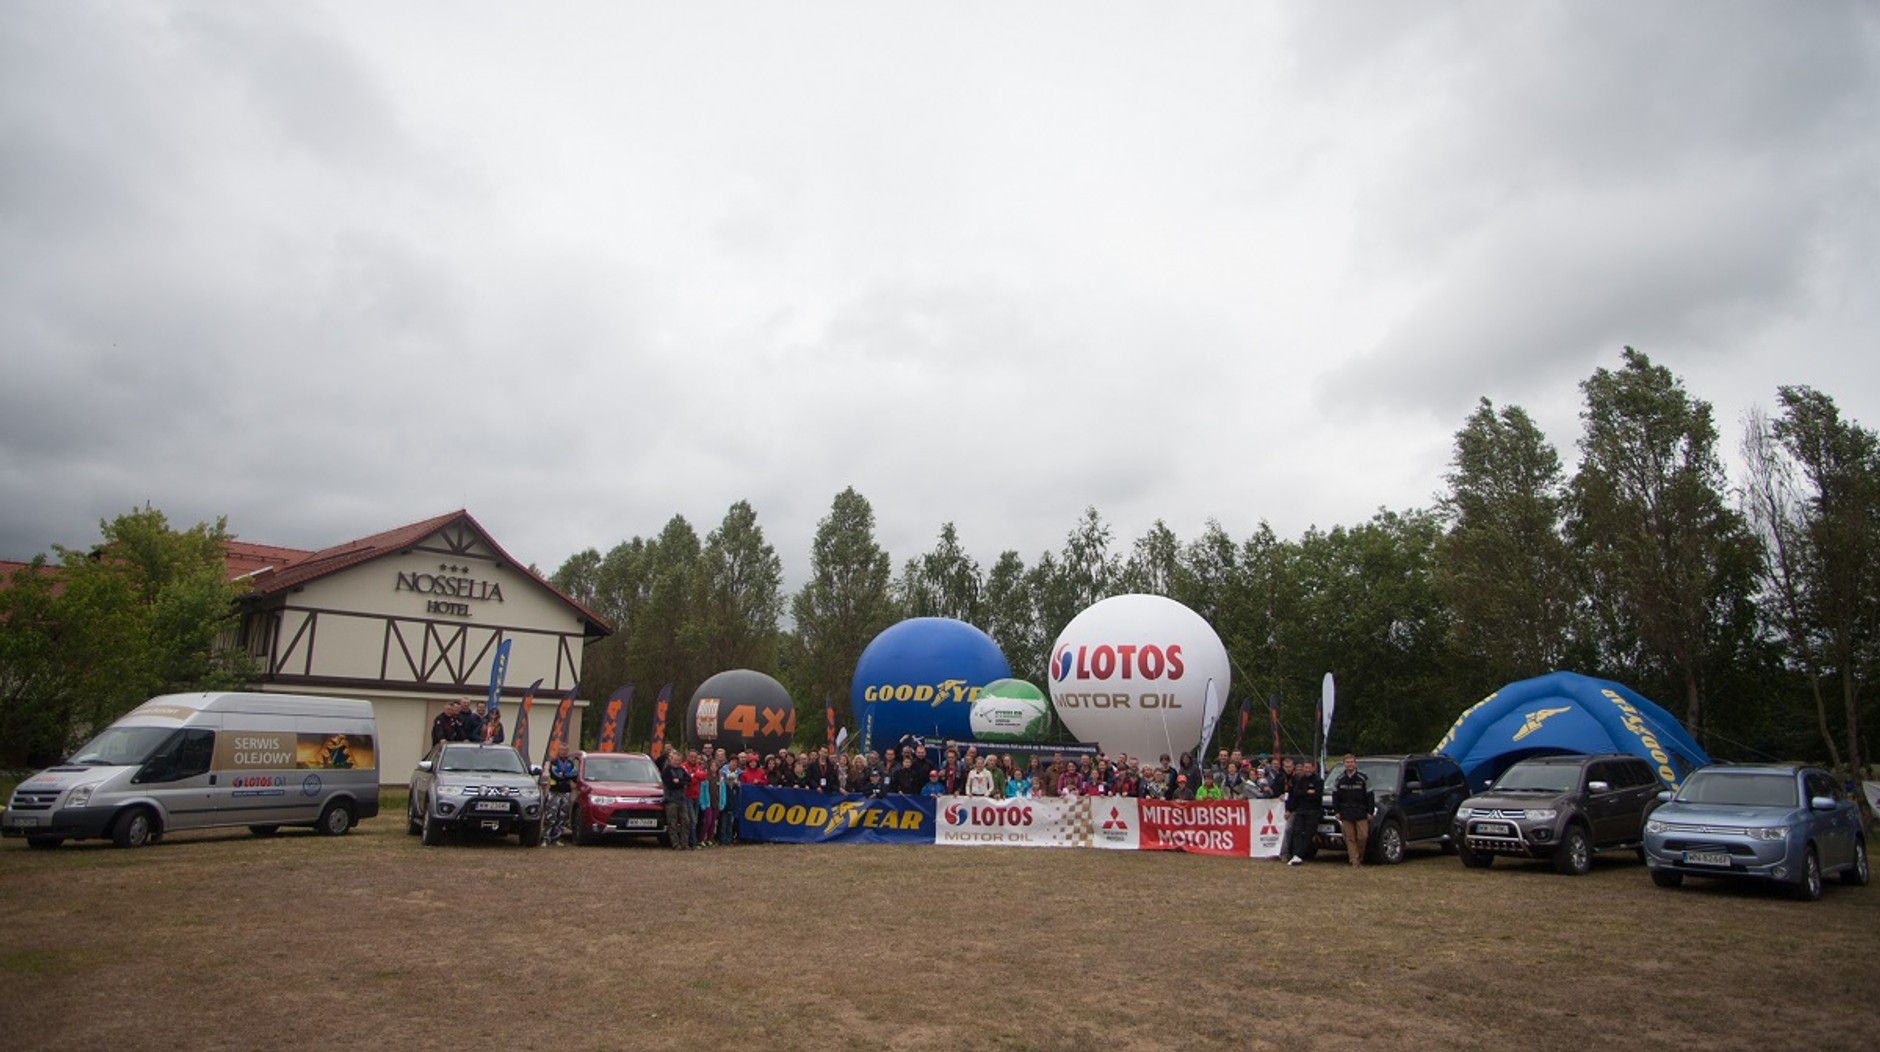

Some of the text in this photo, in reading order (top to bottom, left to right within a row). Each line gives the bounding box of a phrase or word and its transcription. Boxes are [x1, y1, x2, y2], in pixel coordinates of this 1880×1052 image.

[395, 570, 505, 602] NOSSELIA
[426, 600, 473, 617] HOTEL
[1076, 644, 1185, 681] LOTOS
[1054, 693, 1182, 709] MOTOR OIL
[234, 737, 280, 750] SERWIS
[234, 752, 292, 764] OLEJOWY
[244, 776, 273, 787] LOTOS
[971, 806, 1033, 826] LOTOS
[1141, 805, 1246, 826] MITSUBISHI
[945, 831, 1033, 842] MOTOR OIL
[1158, 829, 1234, 850] MOTORS
